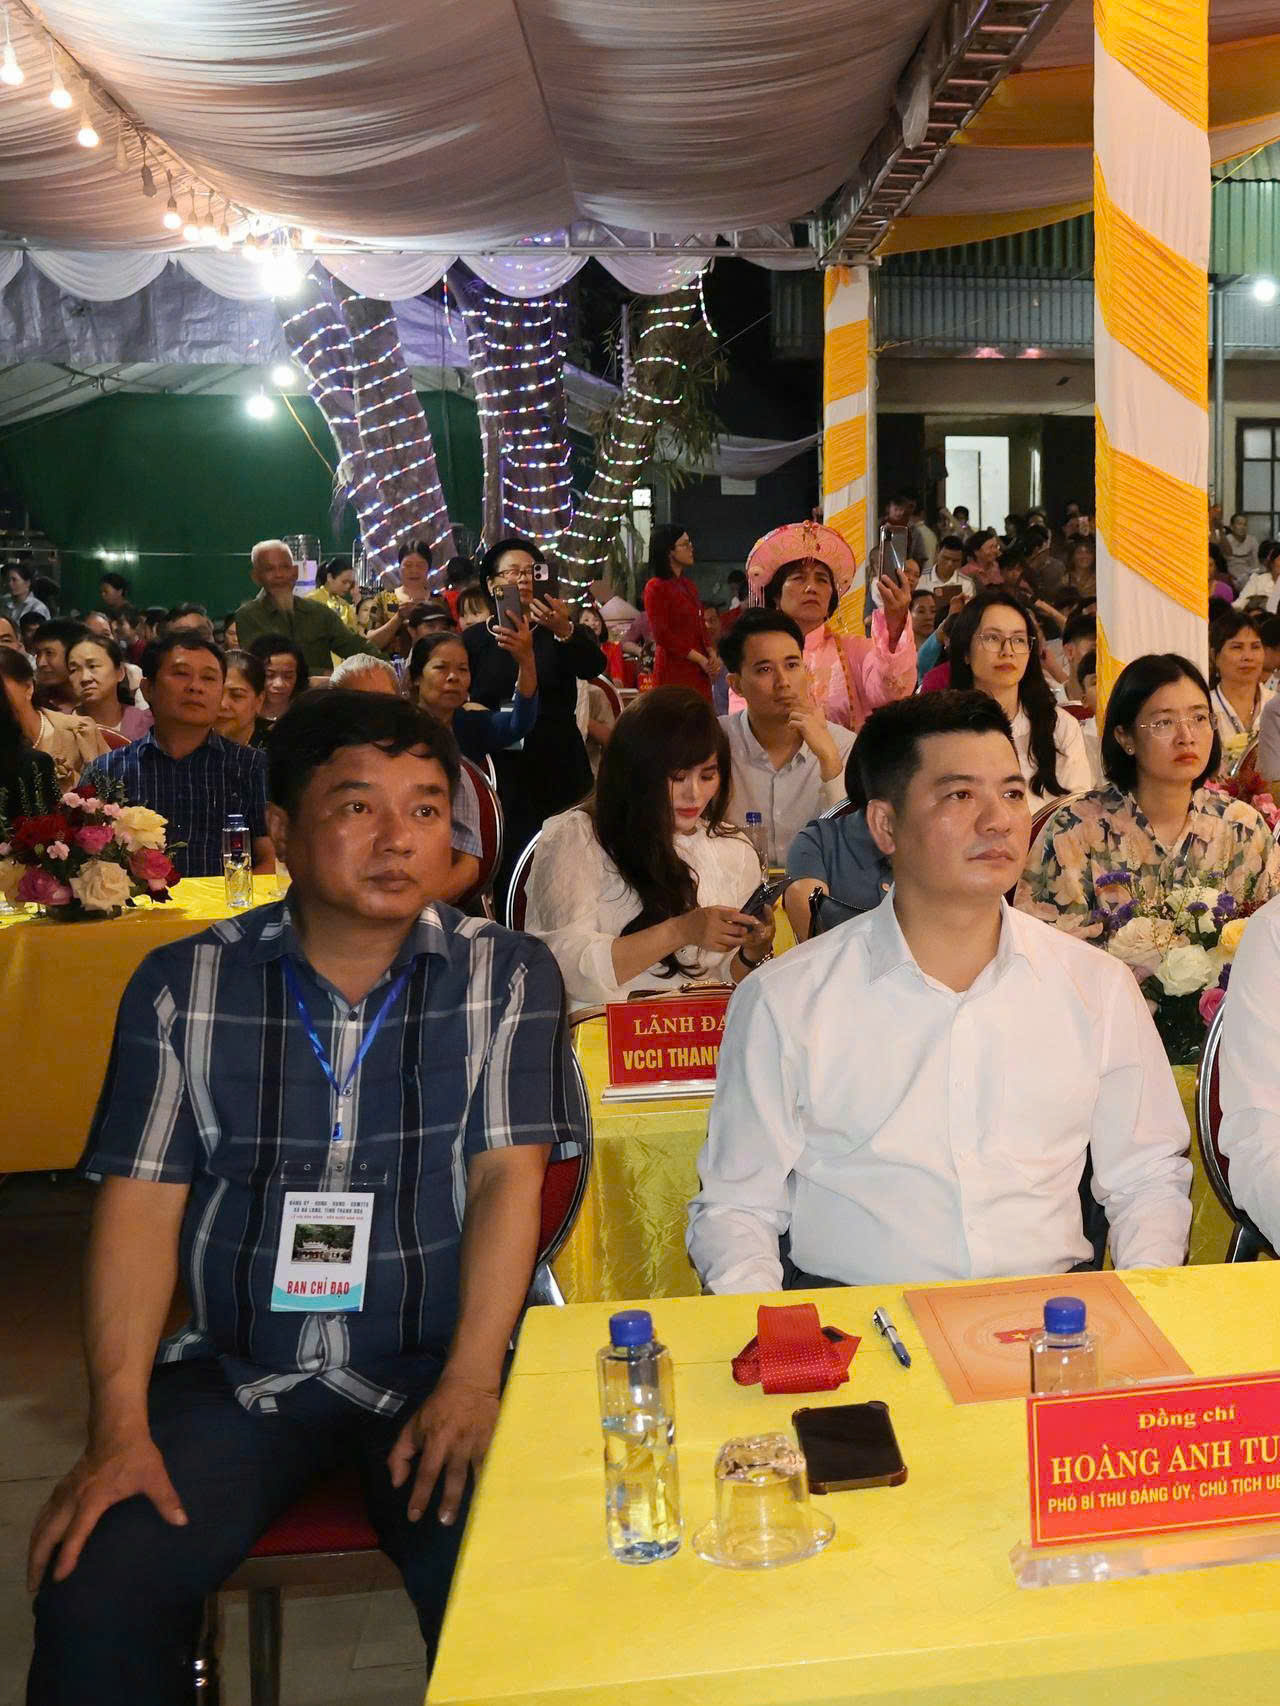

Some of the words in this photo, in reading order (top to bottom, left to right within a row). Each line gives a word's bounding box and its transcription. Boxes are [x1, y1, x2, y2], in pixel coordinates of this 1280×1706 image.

[634, 1014, 694, 1035] LÃNH
[701, 1015, 726, 1031] ĐA
[623, 1049, 663, 1070] VCCI
[287, 1281, 306, 1294] BAN
[330, 1281, 350, 1298] ĐẠO
[1138, 1408, 1196, 1429] Đồng
[1203, 1403, 1237, 1423] chí
[1051, 1444, 1161, 1485] HOÀNG
[1167, 1440, 1232, 1473] ANH
[1048, 1493, 1077, 1513] PHÓ
[1081, 1491, 1095, 1510] BÍ
[1098, 1490, 1127, 1508] THƯ
[1130, 1485, 1168, 1505] ĐẢNG
[1200, 1476, 1227, 1497] CHỦ
[1232, 1477, 1262, 1496] TỊCH
